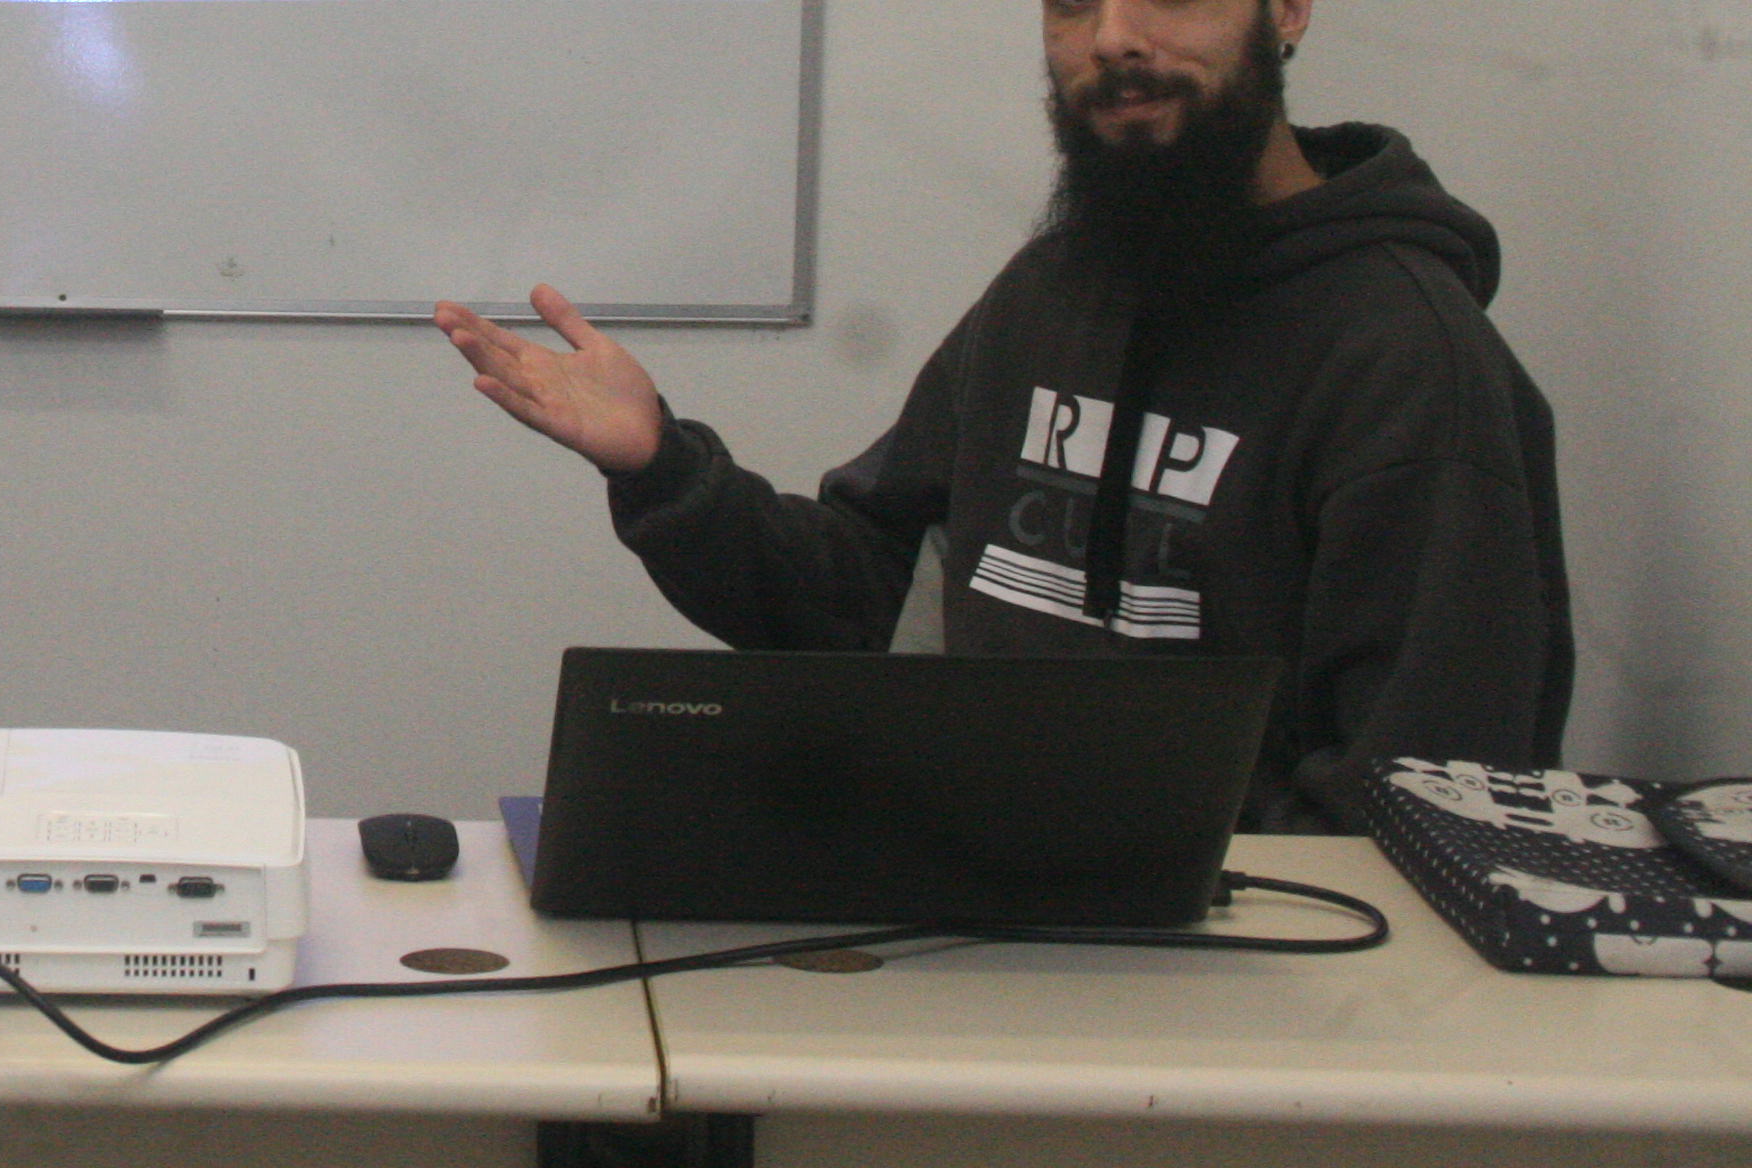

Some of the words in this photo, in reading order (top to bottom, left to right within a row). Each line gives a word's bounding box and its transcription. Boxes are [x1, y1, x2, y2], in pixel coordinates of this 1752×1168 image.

[1022, 387, 1237, 506] RP
[1009, 489, 1192, 581] CUL
[609, 698, 723, 716] Lenovo
